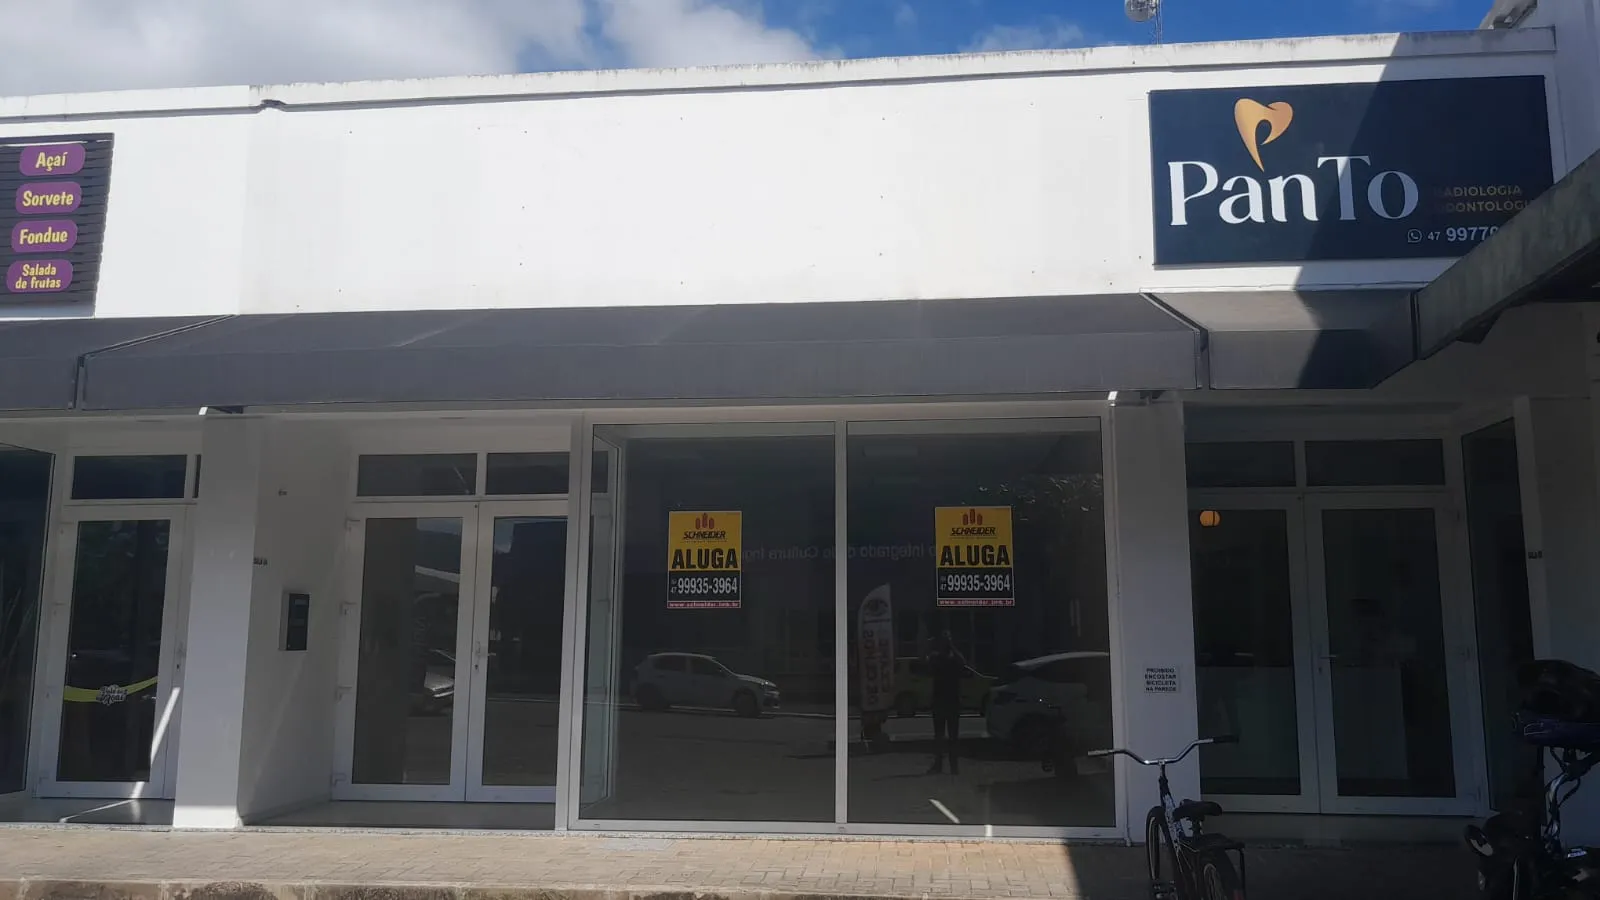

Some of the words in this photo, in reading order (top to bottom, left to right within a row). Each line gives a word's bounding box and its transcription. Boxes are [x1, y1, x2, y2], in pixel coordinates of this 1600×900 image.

[35, 151, 68, 171] Açaí
[22, 190, 74, 207] Sorvete
[1168, 155, 1419, 226] PanTo
[19, 226, 69, 245] Fondue
[1427, 231, 1441, 241] 47
[22, 263, 57, 277] Salada
[15, 277, 27, 290] de
[30, 276, 61, 289] frutas
[683, 530, 726, 539] SCHNEIDER
[951, 526, 996, 535] SCHNEIDER
[671, 547, 738, 569] ALUGA
[940, 544, 1010, 566] ALUGA
[677, 577, 738, 594] 99935-3964
[947, 574, 1010, 591] 99935-3964
